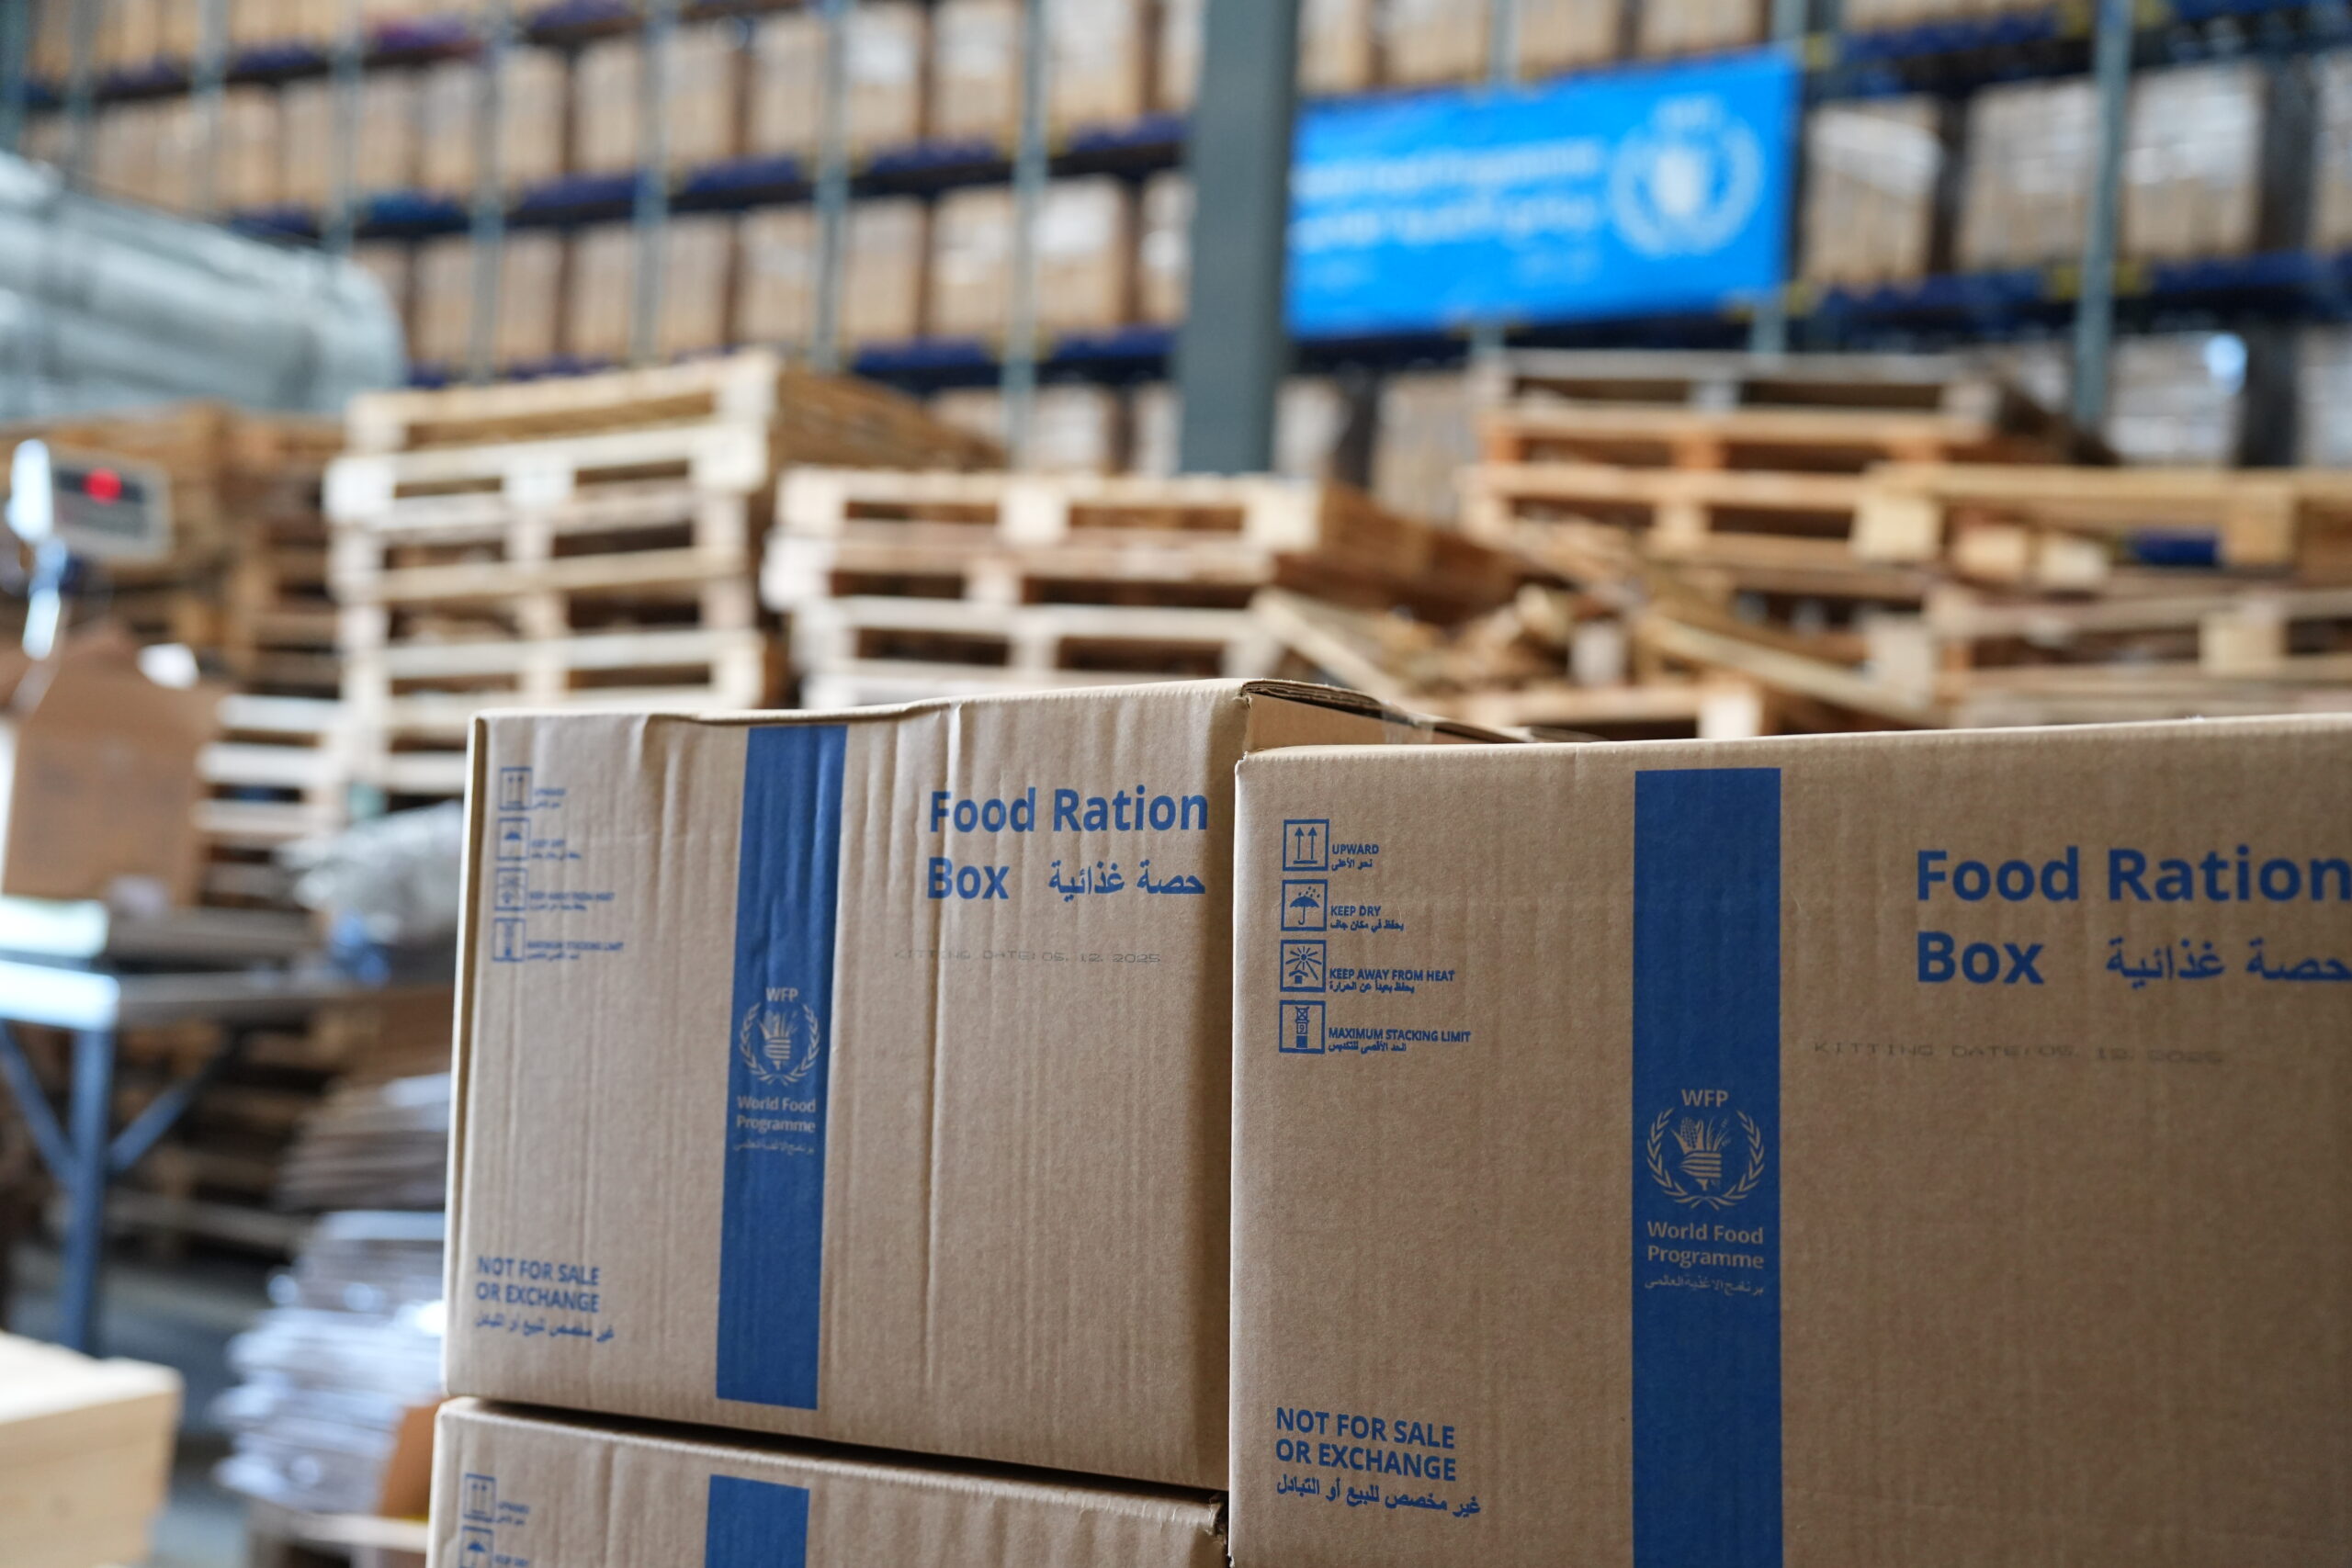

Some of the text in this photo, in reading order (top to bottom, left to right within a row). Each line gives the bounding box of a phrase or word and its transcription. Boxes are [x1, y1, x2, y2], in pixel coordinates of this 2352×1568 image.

[929, 784, 1209, 833] Food Ration
[1331, 843, 1380, 855] UPWARD
[926, 856, 1010, 900] Box
[1047, 859, 1206, 903] حصة غذائية
[1917, 844, 2352, 903] Food Ration
[1330, 905, 1382, 917] KEEP DRY
[1112, 953, 1161, 964] 2025
[1917, 930, 2045, 987] Box
[2105, 936, 2352, 990] حصة غذائية
[1329, 968, 1455, 982] KEEP AWAY FROM HEAT
[765, 987, 799, 1003] WFP
[1328, 1027, 1472, 1043] MAXIMUM STACKING LIMIT
[1814, 1042, 1934, 1057] KITTING
[736, 1095, 817, 1113] World Food
[1680, 1088, 1730, 1108] WFP
[736, 1113, 817, 1134] Programme
[1646, 1220, 1764, 1245] World Food
[1646, 1244, 1765, 1269] Programme
[477, 1256, 600, 1286] NOT FOR SALE
[476, 1281, 600, 1314] OR EXCHANGE
[1275, 1406, 1455, 1450] NOT FOR SALE
[1275, 1438, 1456, 1482] OR EXCHANGE
[1276, 1473, 1481, 1517] غير مخصص للبيع أو التبادل
